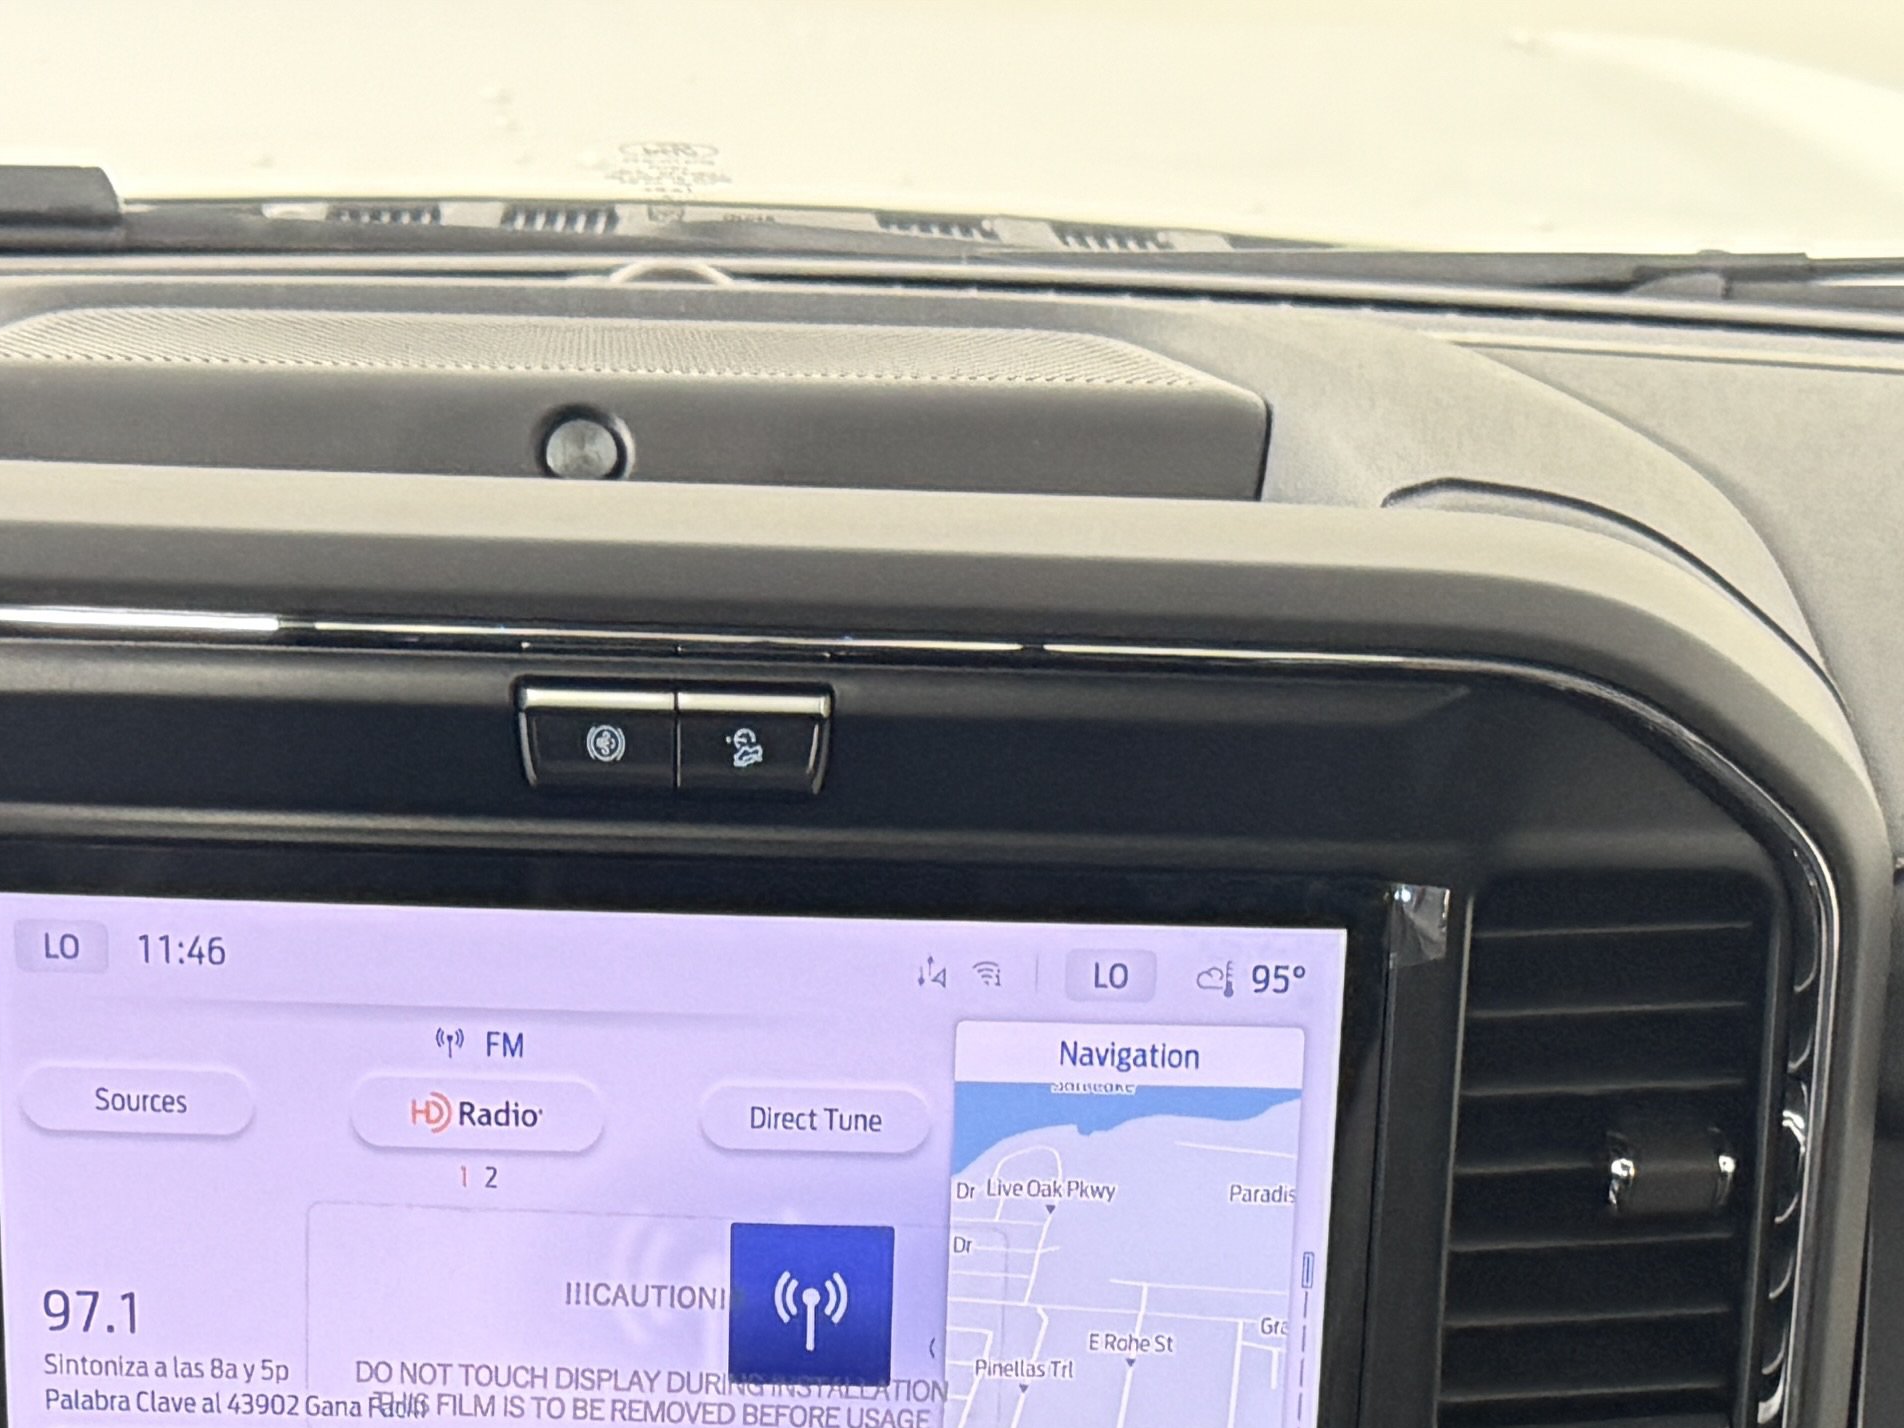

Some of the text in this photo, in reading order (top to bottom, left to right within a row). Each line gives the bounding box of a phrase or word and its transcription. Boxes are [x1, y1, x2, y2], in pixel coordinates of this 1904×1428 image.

[43, 933, 81, 961] LO
[138, 933, 228, 966] 11:46
[1094, 962, 1129, 989] LO
[1251, 962, 1307, 994] 95°
[486, 1030, 525, 1060] FM
[1059, 1040, 1200, 1074] Navigation
[94, 1086, 188, 1114] Sources
[411, 1094, 540, 1131] HD Radio
[749, 1106, 883, 1134] Direct Tune
[485, 1166, 498, 1188] 2
[957, 1181, 975, 1199] Dr
[986, 1178, 1117, 1202] Live Oak Pkwy
[953, 1236, 972, 1254] Dr
[42, 1289, 139, 1334] 97.1
[1089, 1334, 1100, 1351] E
[1154, 1335, 1174, 1352] St
[44, 1353, 289, 1384] Sintoniza a las 8a y 5p
[355, 1360, 393, 1384] DO
[400, 1361, 452, 1386] NOT
[458, 1363, 547, 1389] TOUCH
[555, 1366, 662, 1393] DISPLAY
[667, 1370, 764, 1397] DURING
[975, 1358, 1073, 1378] Pinellas Trl
[45, 1388, 130, 1412] Palabra
[136, 1390, 196, 1414] Clave
[201, 1390, 222, 1415] al
[227, 1392, 298, 1416] 43902
[305, 1394, 362, 1417] Gana
[437, 1393, 495, 1418] FILM
[504, 1395, 525, 1418] IS
[531, 1396, 565, 1420] TO
[572, 1398, 605, 1422] BE
[611, 1400, 736, 1427] REMOVED
